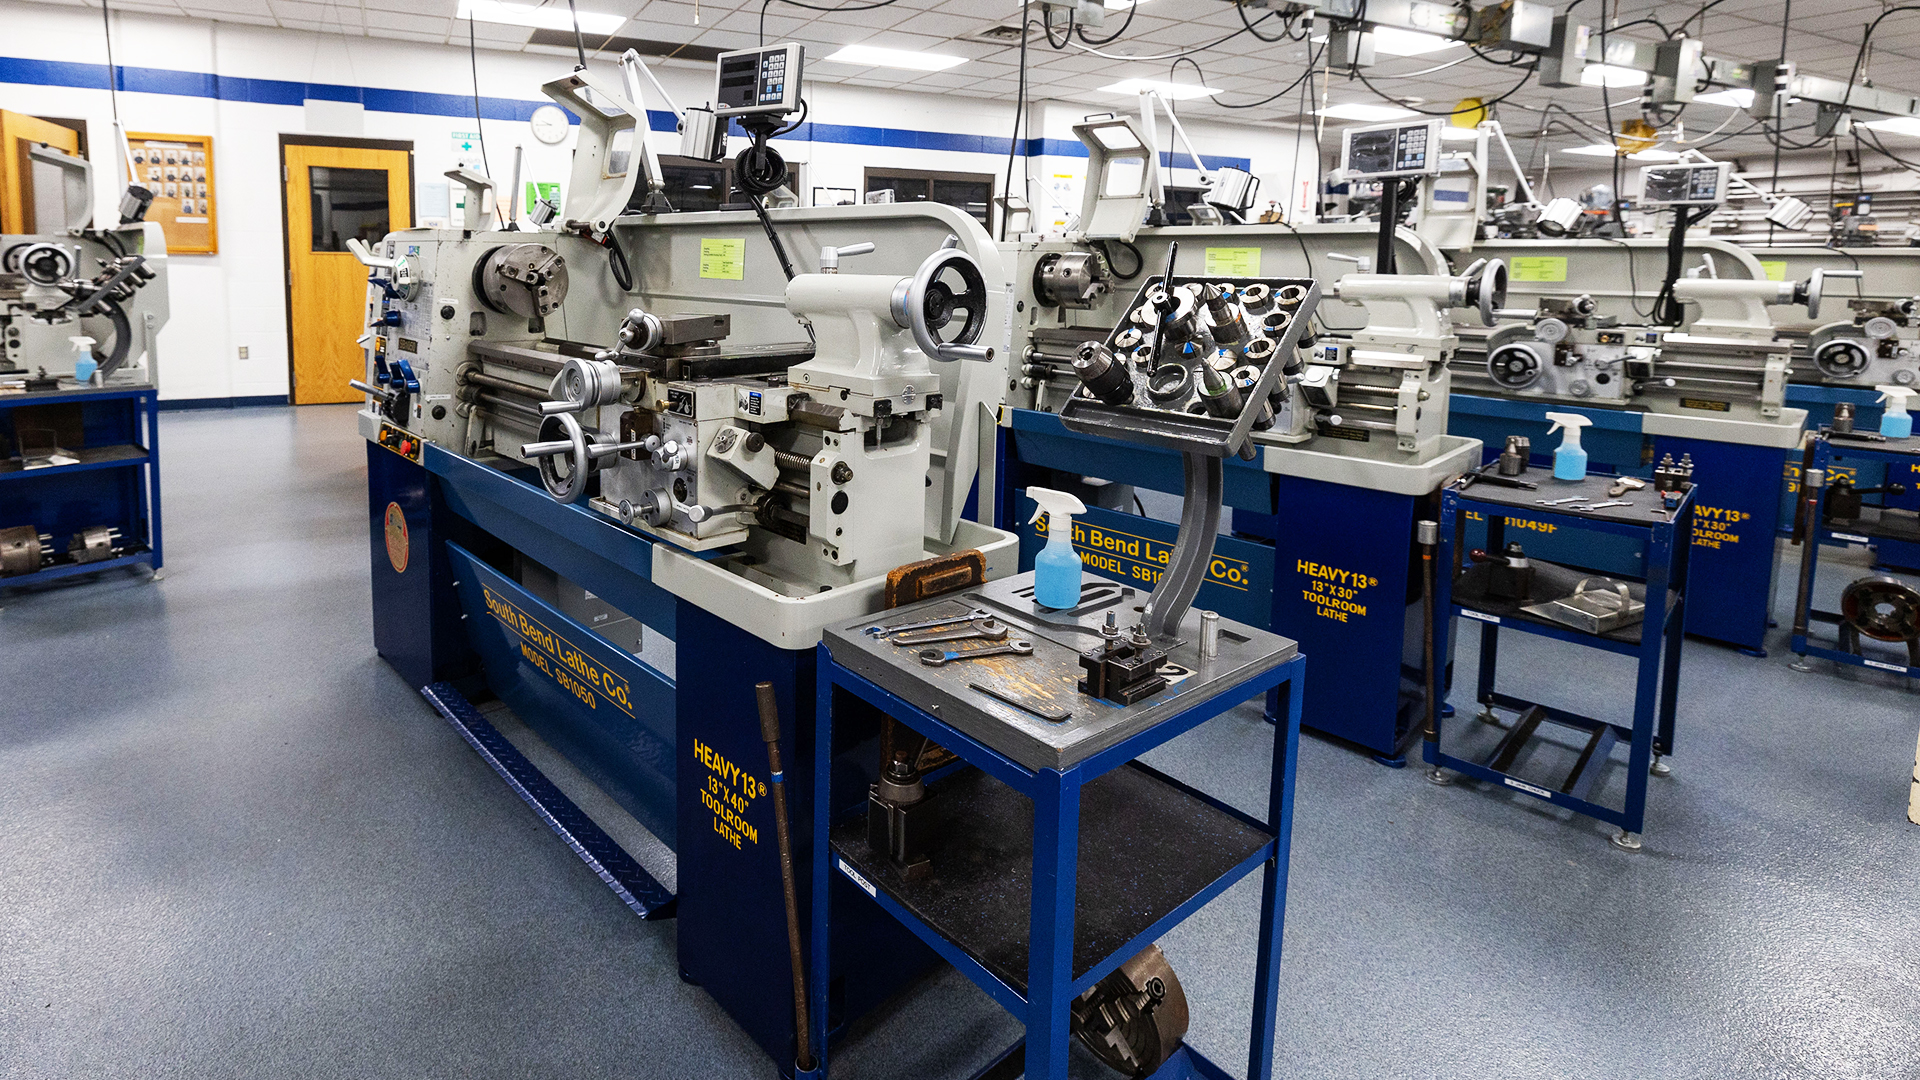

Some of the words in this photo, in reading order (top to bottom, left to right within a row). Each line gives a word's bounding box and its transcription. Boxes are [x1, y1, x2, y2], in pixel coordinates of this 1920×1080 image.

[1090, 532, 1139, 557] Bend
[1080, 551, 1126, 575] MODEL
[1302, 589, 1367, 616] TOOLROOM
[1316, 605, 1348, 623] LATHE
[484, 589, 519, 629] South
[519, 613, 555, 655] Bend
[555, 638, 600, 685] Lathe
[520, 641, 554, 678] MODEL
[555, 667, 596, 709] SB1050
[700, 788, 758, 845] TOOLROOM
[714, 816, 742, 850] LATHE
[843, 863, 857, 879] TOOL
